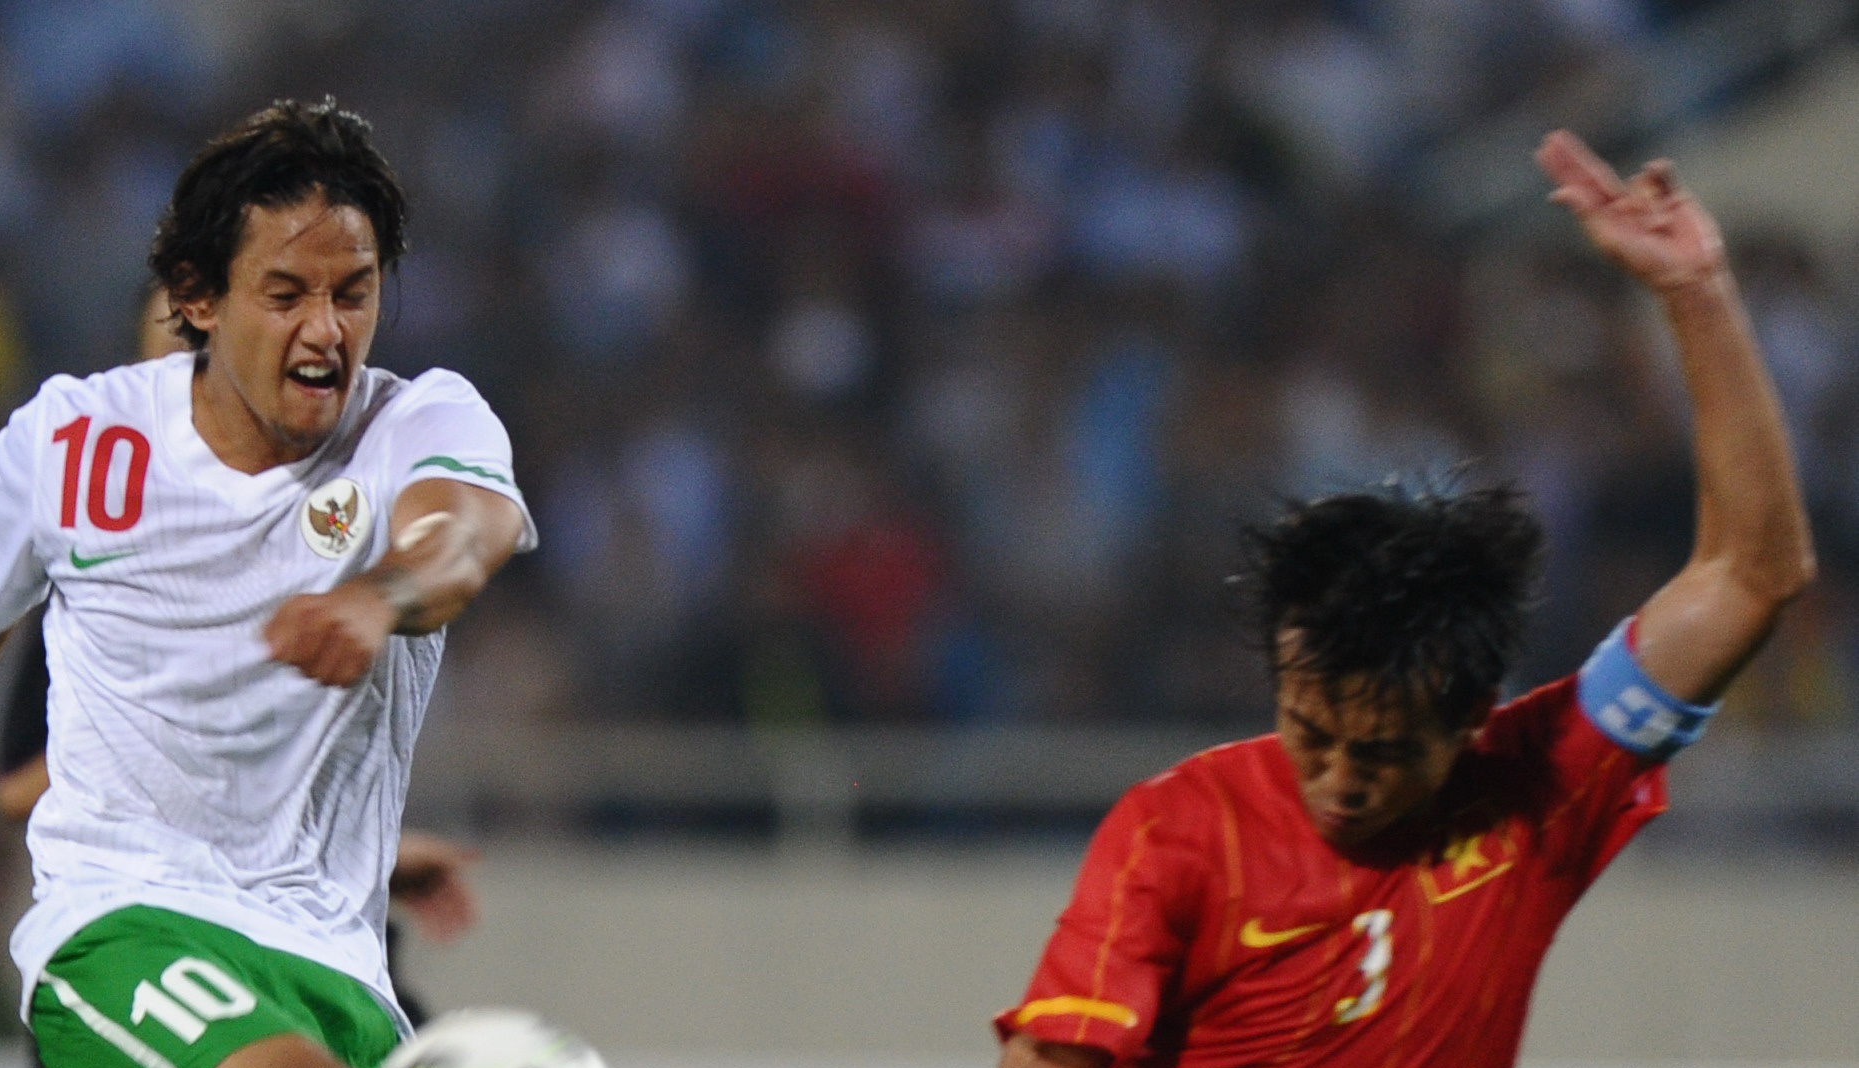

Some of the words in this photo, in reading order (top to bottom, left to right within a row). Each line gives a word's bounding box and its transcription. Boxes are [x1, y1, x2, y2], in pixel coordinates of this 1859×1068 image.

[51, 415, 151, 533] 10
[130, 956, 257, 1046] 10
[1333, 908, 1394, 1027] 3
